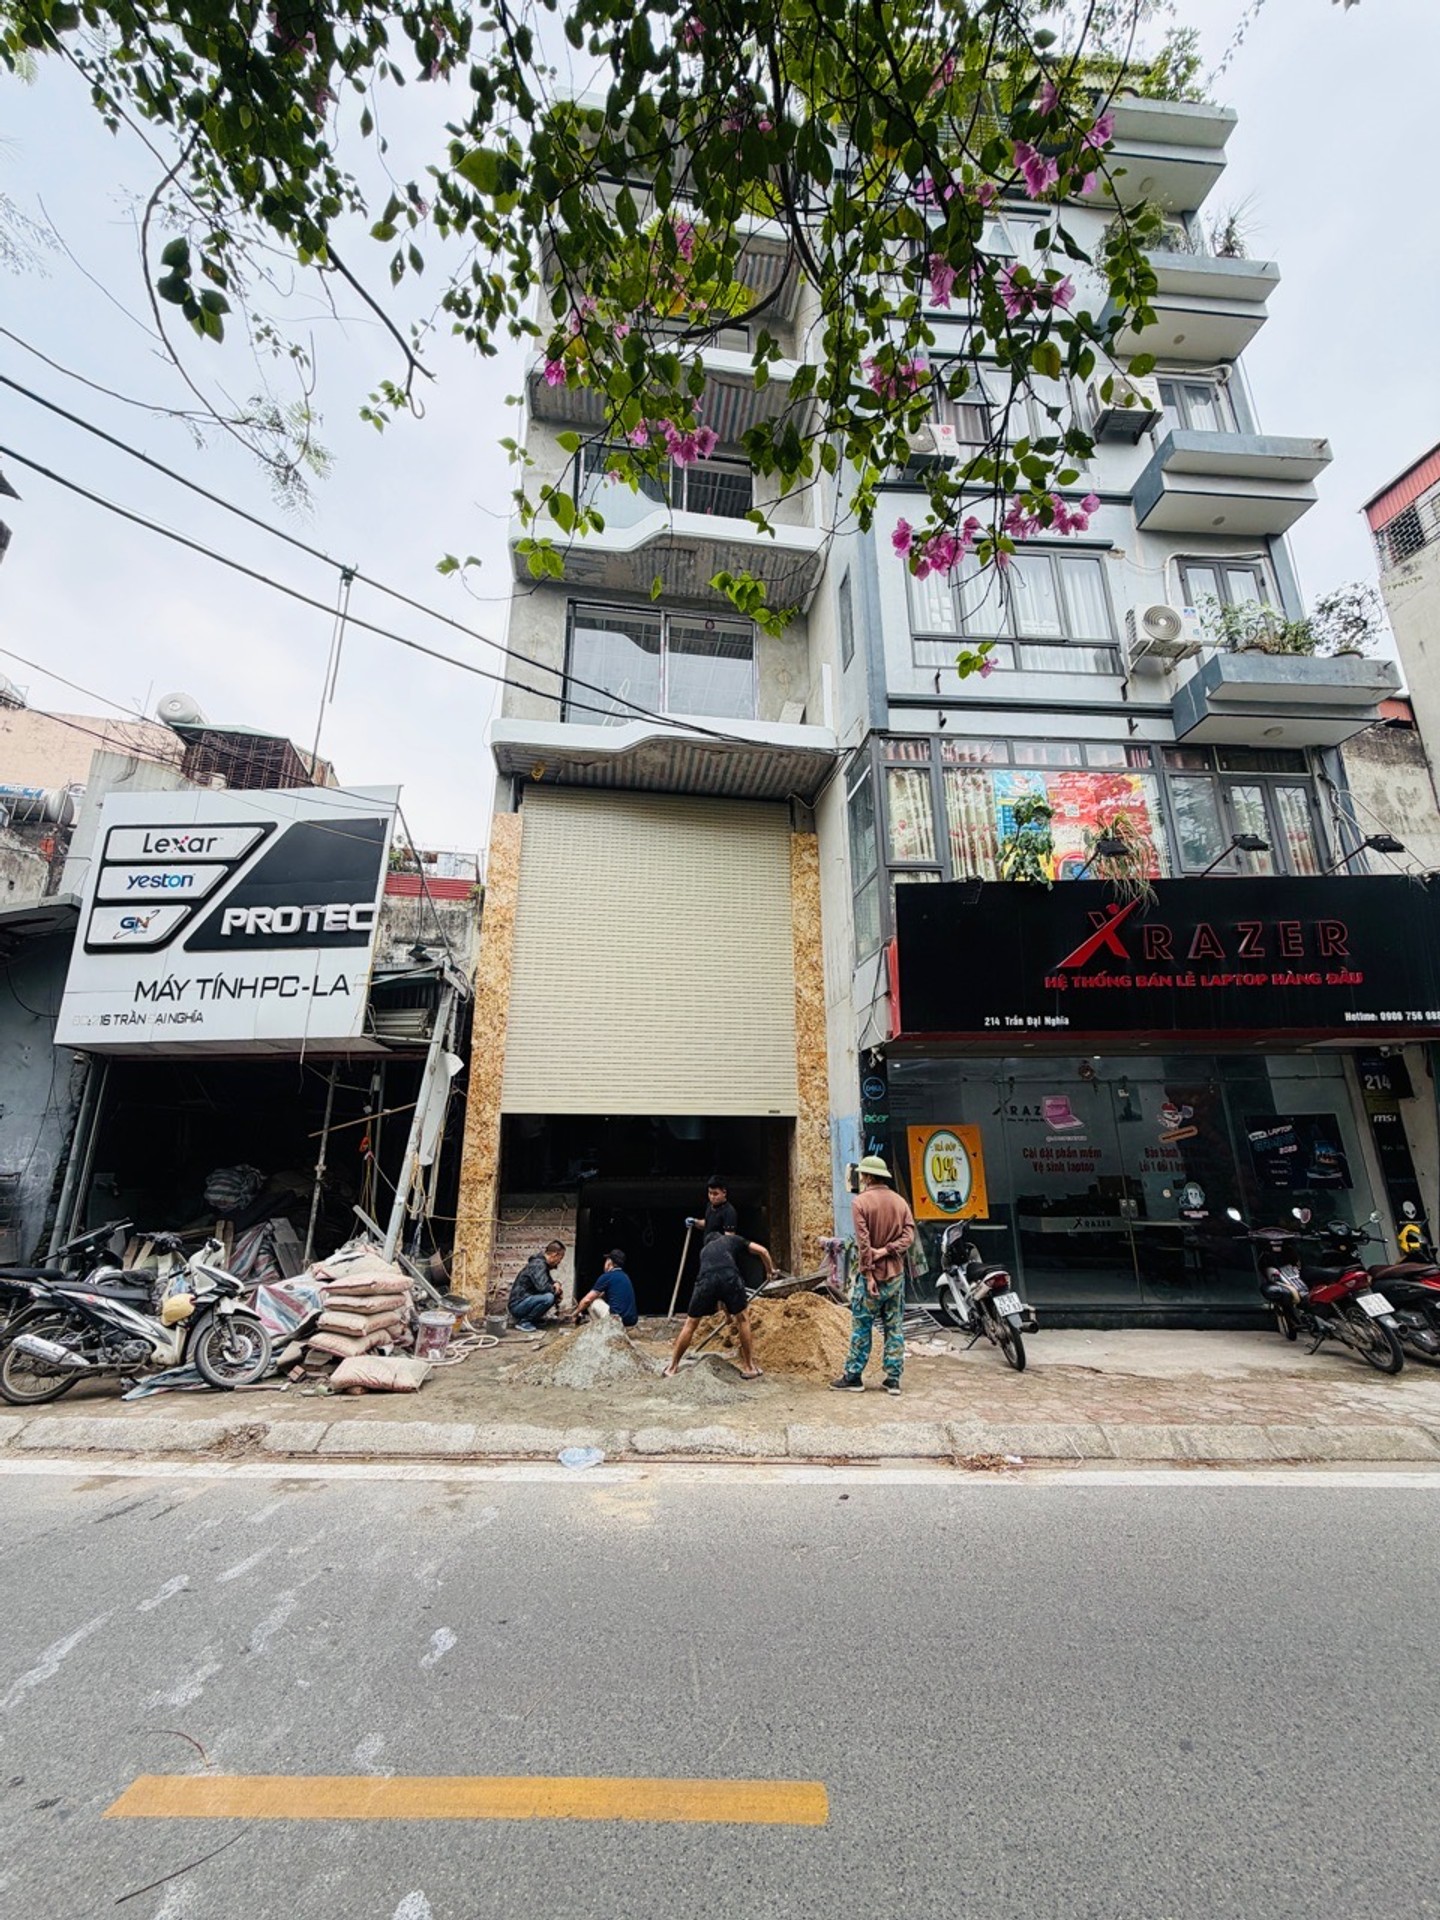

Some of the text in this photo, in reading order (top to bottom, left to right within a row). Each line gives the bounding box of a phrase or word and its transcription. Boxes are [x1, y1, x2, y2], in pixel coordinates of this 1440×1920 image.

[142, 832, 218, 854] Lexar
[126, 873, 194, 890] yeston
[220, 902, 376, 936] PROTEC
[1044, 966, 1364, 991] HỆ THỐNG BÁN LẺ LAPTOP HÀNG ĐẦU
[134, 973, 191, 1002] MÁY
[113, 1010, 147, 1026] TRẦN
[984, 1016, 1001, 1026] 214
[1004, 1014, 1024, 1026] Trần
[1363, 1074, 1393, 1091] 214
[863, 1113, 889, 1124] acer
[1373, 1114, 1397, 1123] msi
